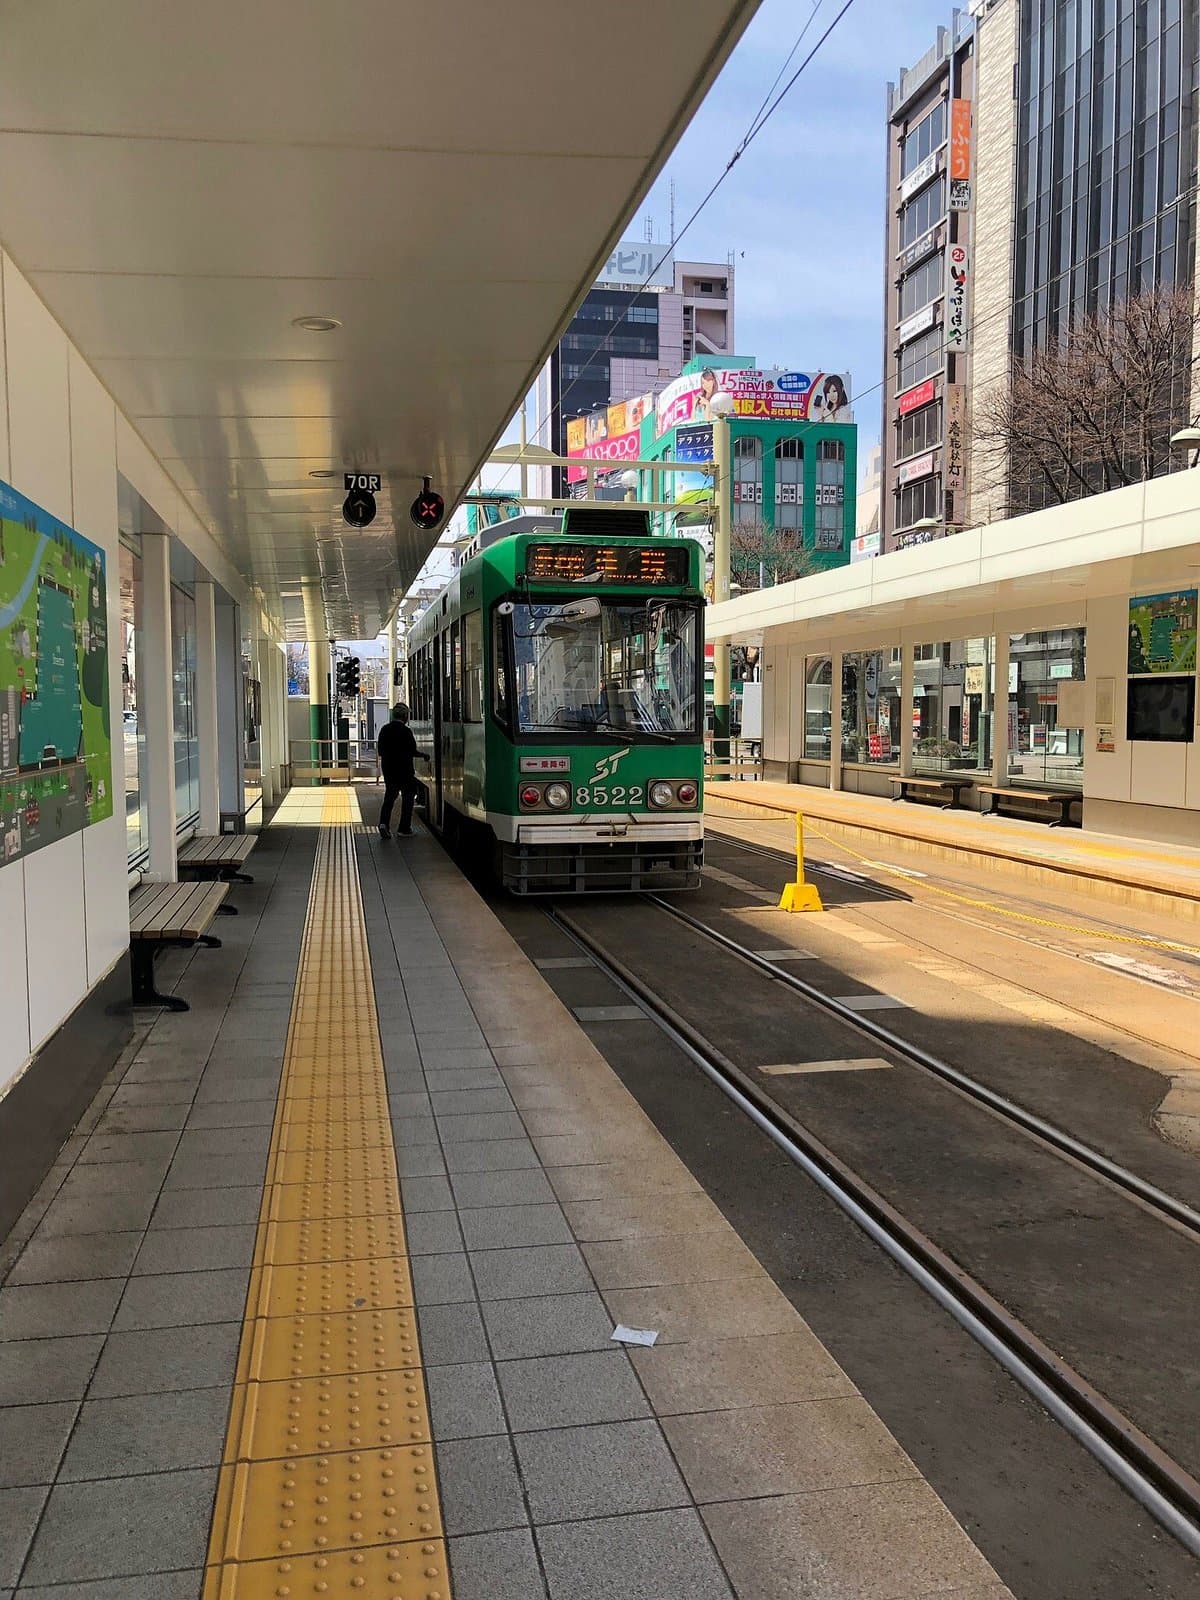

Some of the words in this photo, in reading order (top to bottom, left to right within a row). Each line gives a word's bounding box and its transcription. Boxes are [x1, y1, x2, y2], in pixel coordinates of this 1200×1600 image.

[953, 250, 965, 260] 2F
[678, 434, 713, 446] デラック
[347, 475, 378, 490] 70R
[589, 748, 630, 784] ST
[576, 786, 643, 805] 8522
